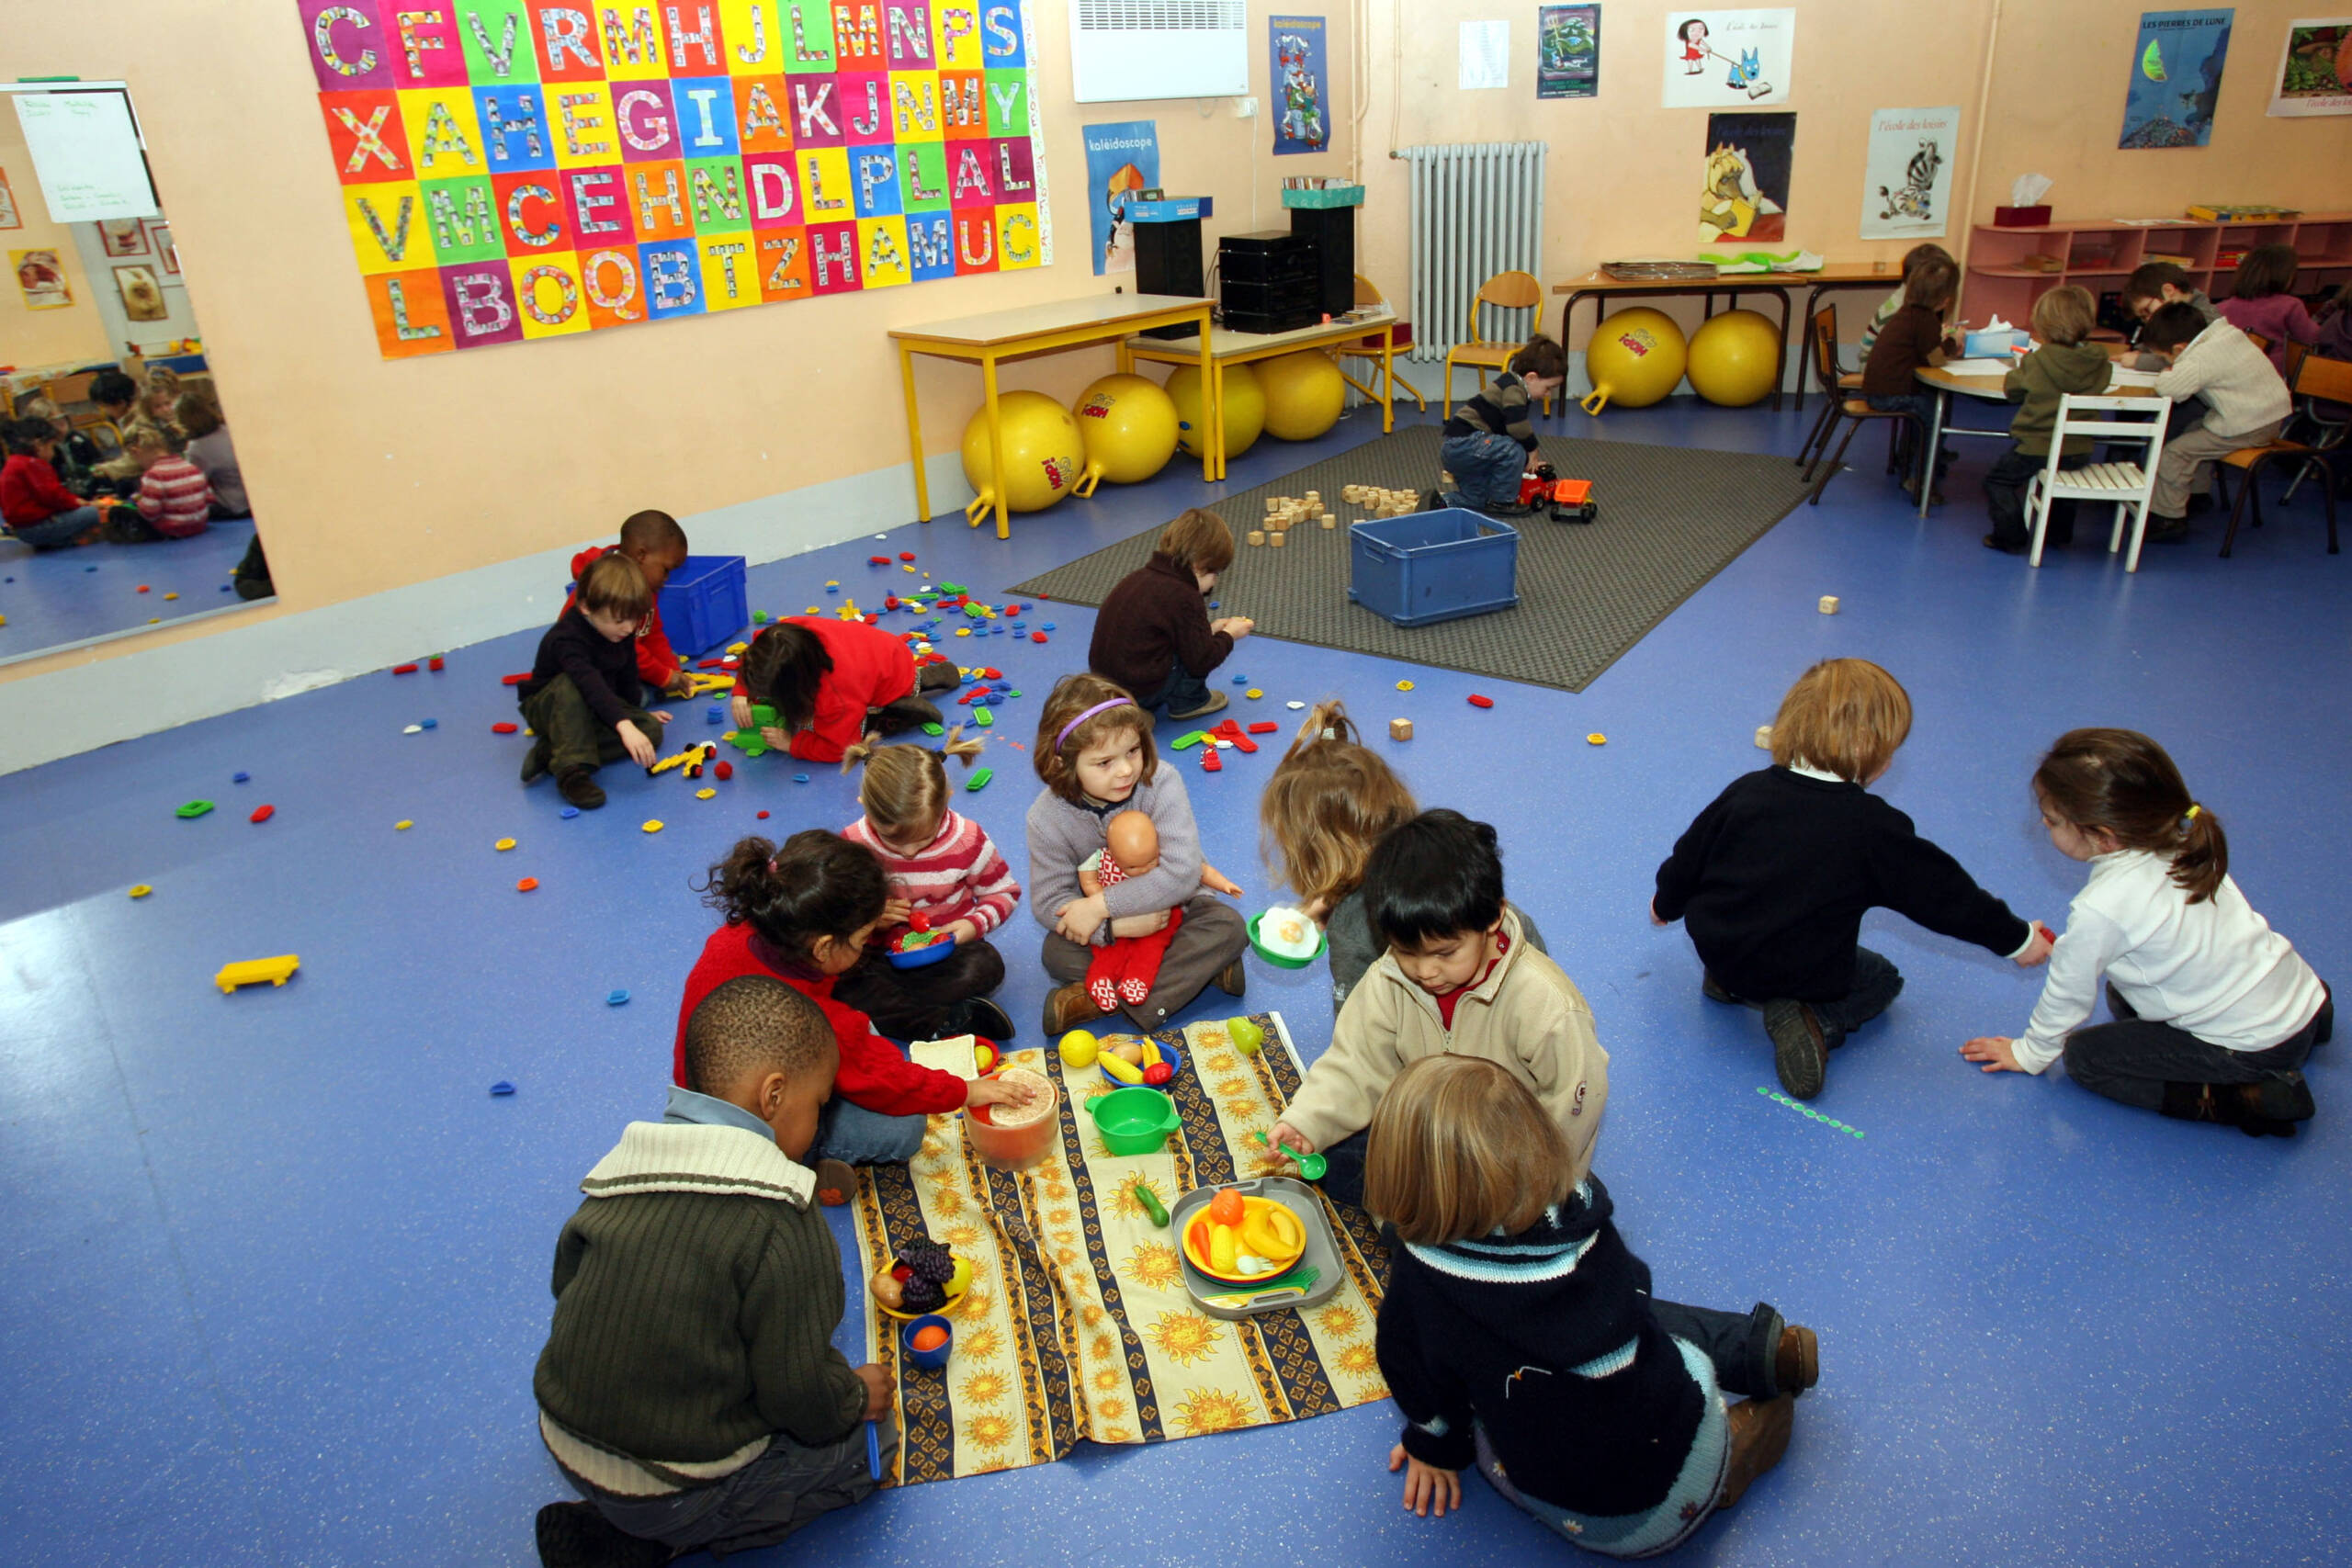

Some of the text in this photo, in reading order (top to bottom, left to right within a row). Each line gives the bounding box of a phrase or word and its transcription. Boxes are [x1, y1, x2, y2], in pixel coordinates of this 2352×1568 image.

[315, 7, 377, 77] C
[397, 11, 444, 77] F
[468, 11, 517, 77] V
[539, 7, 600, 70] R
[602, 7, 658, 66] M
[666, 6, 717, 67] H
[737, 5, 766, 64] J
[790, 5, 829, 62] L
[835, 6, 881, 57] M
[888, 6, 929, 59] N
[942, 8, 974, 62] P
[985, 6, 1017, 57] S
[2143, 21, 2157, 29] LES
[2157, 19, 2191, 28] PIERRES
[2192, 18, 2203, 27] DE
[2205, 17, 2225, 26] LUNE
[332, 106, 405, 173] X
[421, 102, 478, 167] A
[485, 96, 542, 160] H
[558, 93, 610, 156] E
[618, 90, 671, 151] G
[688, 89, 724, 147] I
[743, 83, 787, 140] A
[795, 83, 841, 138] K
[853, 81, 876, 135] J
[895, 81, 936, 132] N
[942, 78, 981, 126] M
[989, 82, 1022, 130] Y
[1089, 137, 1153, 152] kaléidoscope
[356, 197, 413, 262] V
[429, 186, 495, 248] M
[507, 184, 560, 246] C
[571, 174, 623, 234] E
[636, 169, 684, 230] H
[692, 165, 742, 222] N
[751, 163, 793, 220] D
[808, 157, 845, 210] L
[859, 154, 893, 209] P
[908, 151, 942, 200] L
[955, 148, 991, 199] A
[1000, 143, 1031, 191] L
[388, 279, 441, 341] L
[452, 273, 513, 337] B
[521, 265, 577, 324] O
[584, 251, 641, 321] Q
[648, 251, 695, 310] B
[708, 243, 745, 299] T
[763, 238, 800, 290] Z
[815, 231, 855, 286] H
[868, 224, 905, 276] A
[910, 220, 949, 267] M
[959, 220, 991, 265] U
[1003, 214, 1033, 262] C
